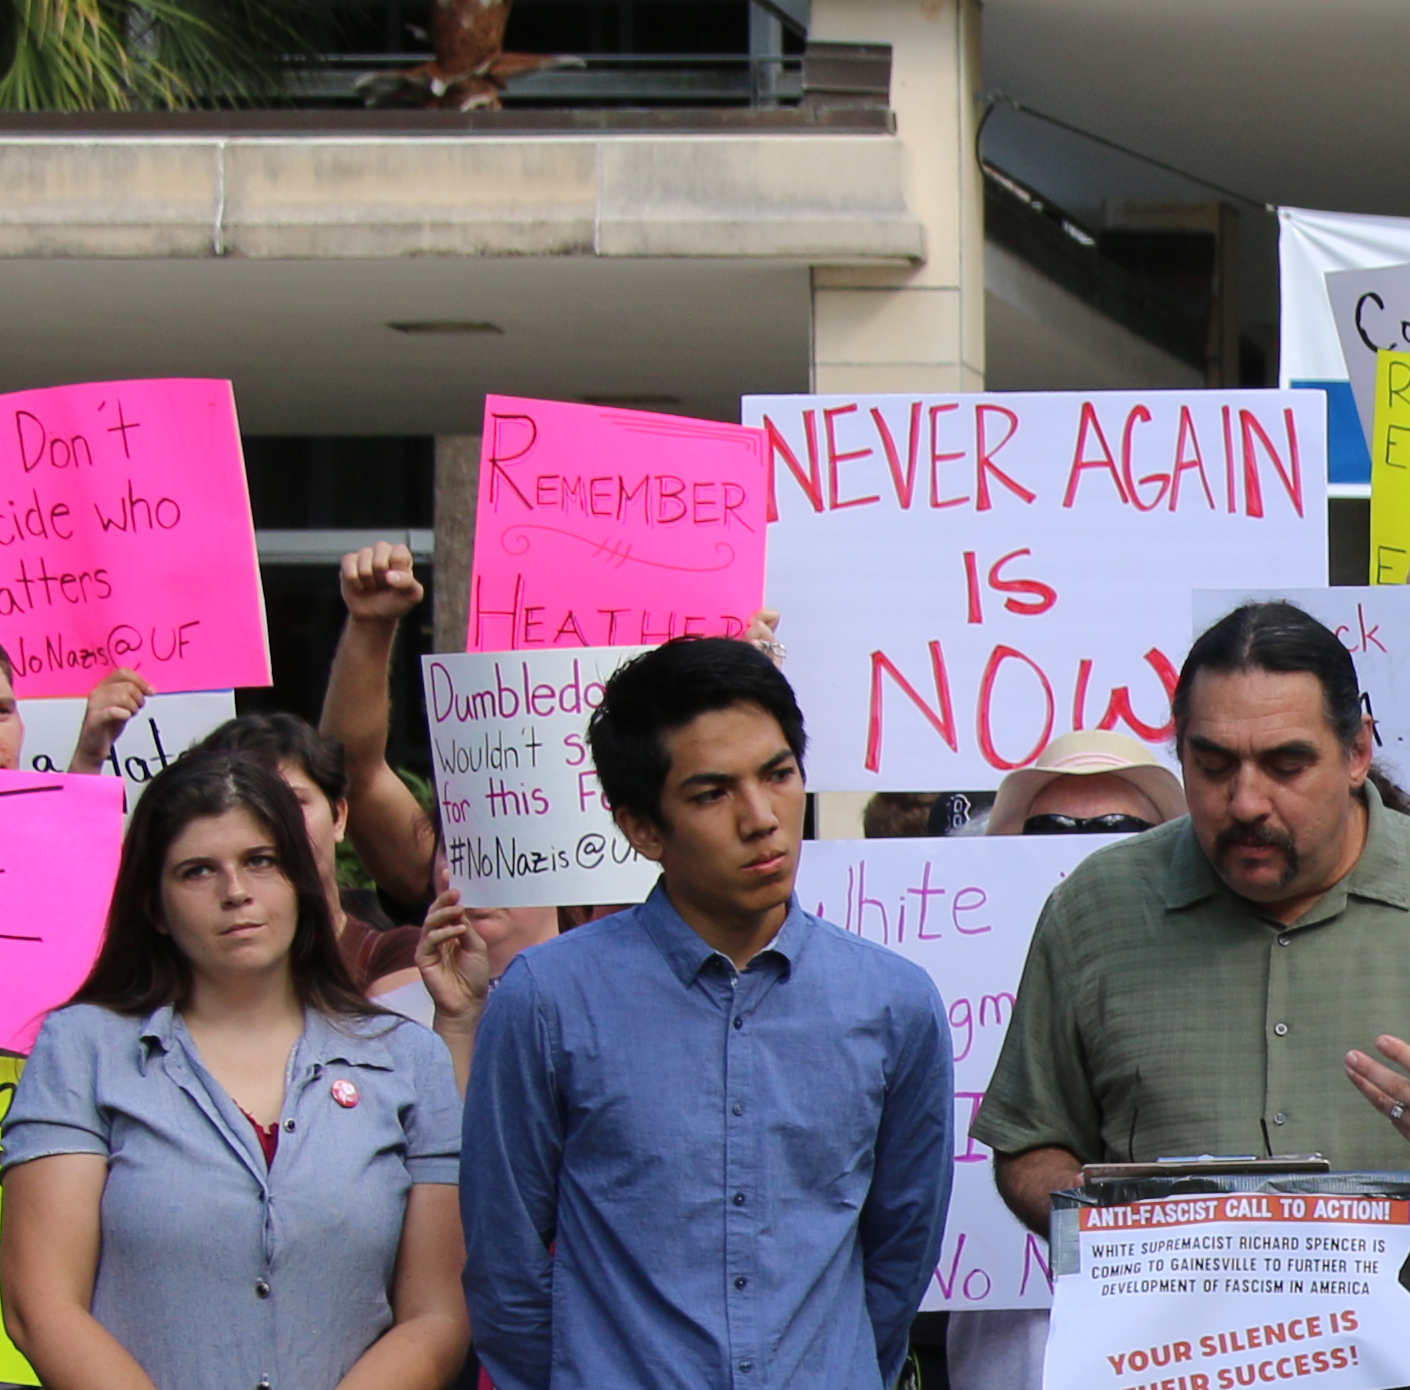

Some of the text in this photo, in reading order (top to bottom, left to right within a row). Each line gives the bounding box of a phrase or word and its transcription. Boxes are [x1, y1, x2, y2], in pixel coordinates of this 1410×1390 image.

[16, 399, 140, 473] Don't
[764, 401, 1304, 522] NEVER AGAIN
[490, 413, 755, 533] REMEMBER
[97, 479, 181, 534] who
[963, 548, 1058, 625] IS
[865, 639, 1180, 773] NOW
[441, 784, 470, 824] for
[486, 777, 549, 818] this
[450, 833, 639, 881] #NoNazis@U
[1087, 1198, 1391, 1227] ANTI-FASCIST CALL TO ACTION!
[1091, 1236, 1386, 1258] WHITE SUPREMACIST RICHARD SPENCER IS
[1091, 1257, 1380, 1280] COMING TO GAINESVILLE TO FURTHER THE
[1101, 1278, 1371, 1297] DEVELOPMENT OF FASCISM IN AMERICA
[1107, 1309, 1360, 1377] YOUR SILENCE IS
[1217, 1345, 1360, 1390] SUCCESS!
